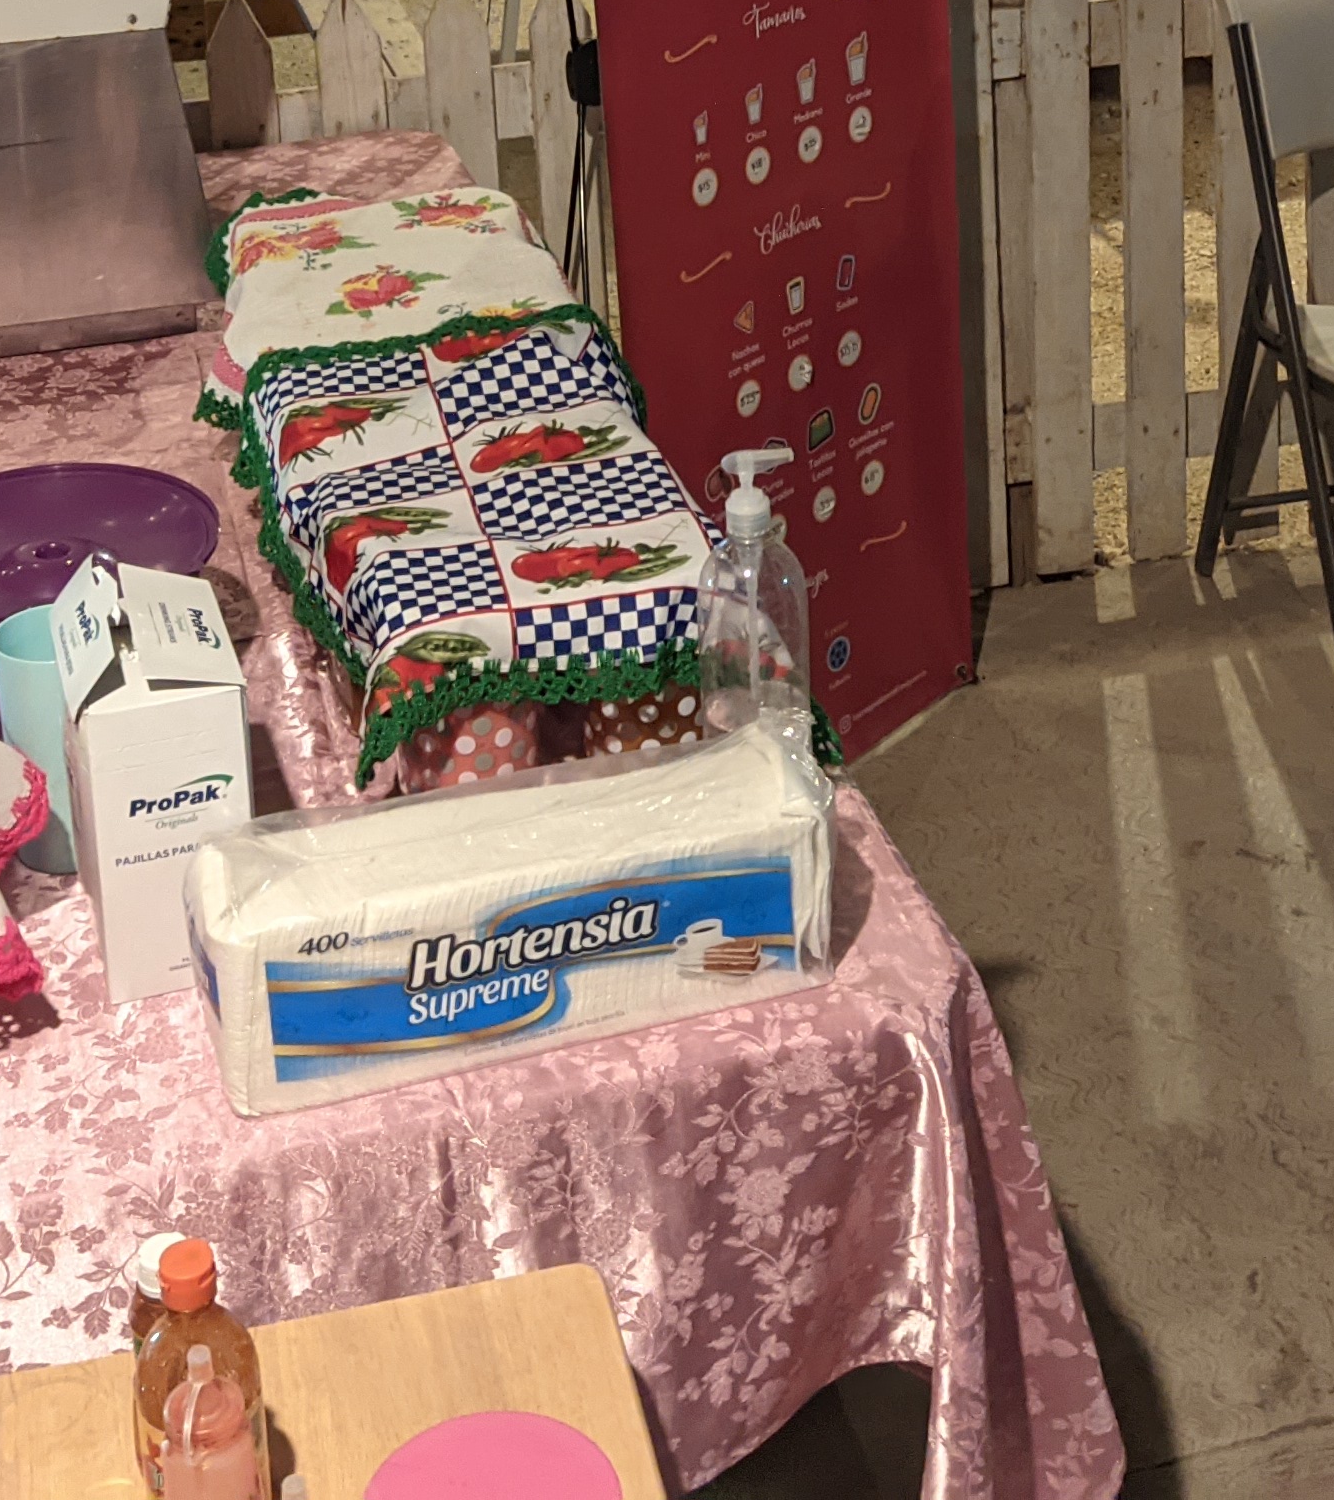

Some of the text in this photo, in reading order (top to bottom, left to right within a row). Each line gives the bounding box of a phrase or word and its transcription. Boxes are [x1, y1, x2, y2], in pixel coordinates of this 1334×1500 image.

[187, 608, 213, 646] ProPak
[129, 785, 220, 818] ProPak
[115, 849, 169, 867] PAJILLAS
[298, 932, 349, 955] 400
[408, 898, 660, 992] Hortensia
[407, 967, 550, 1025] Supreme
